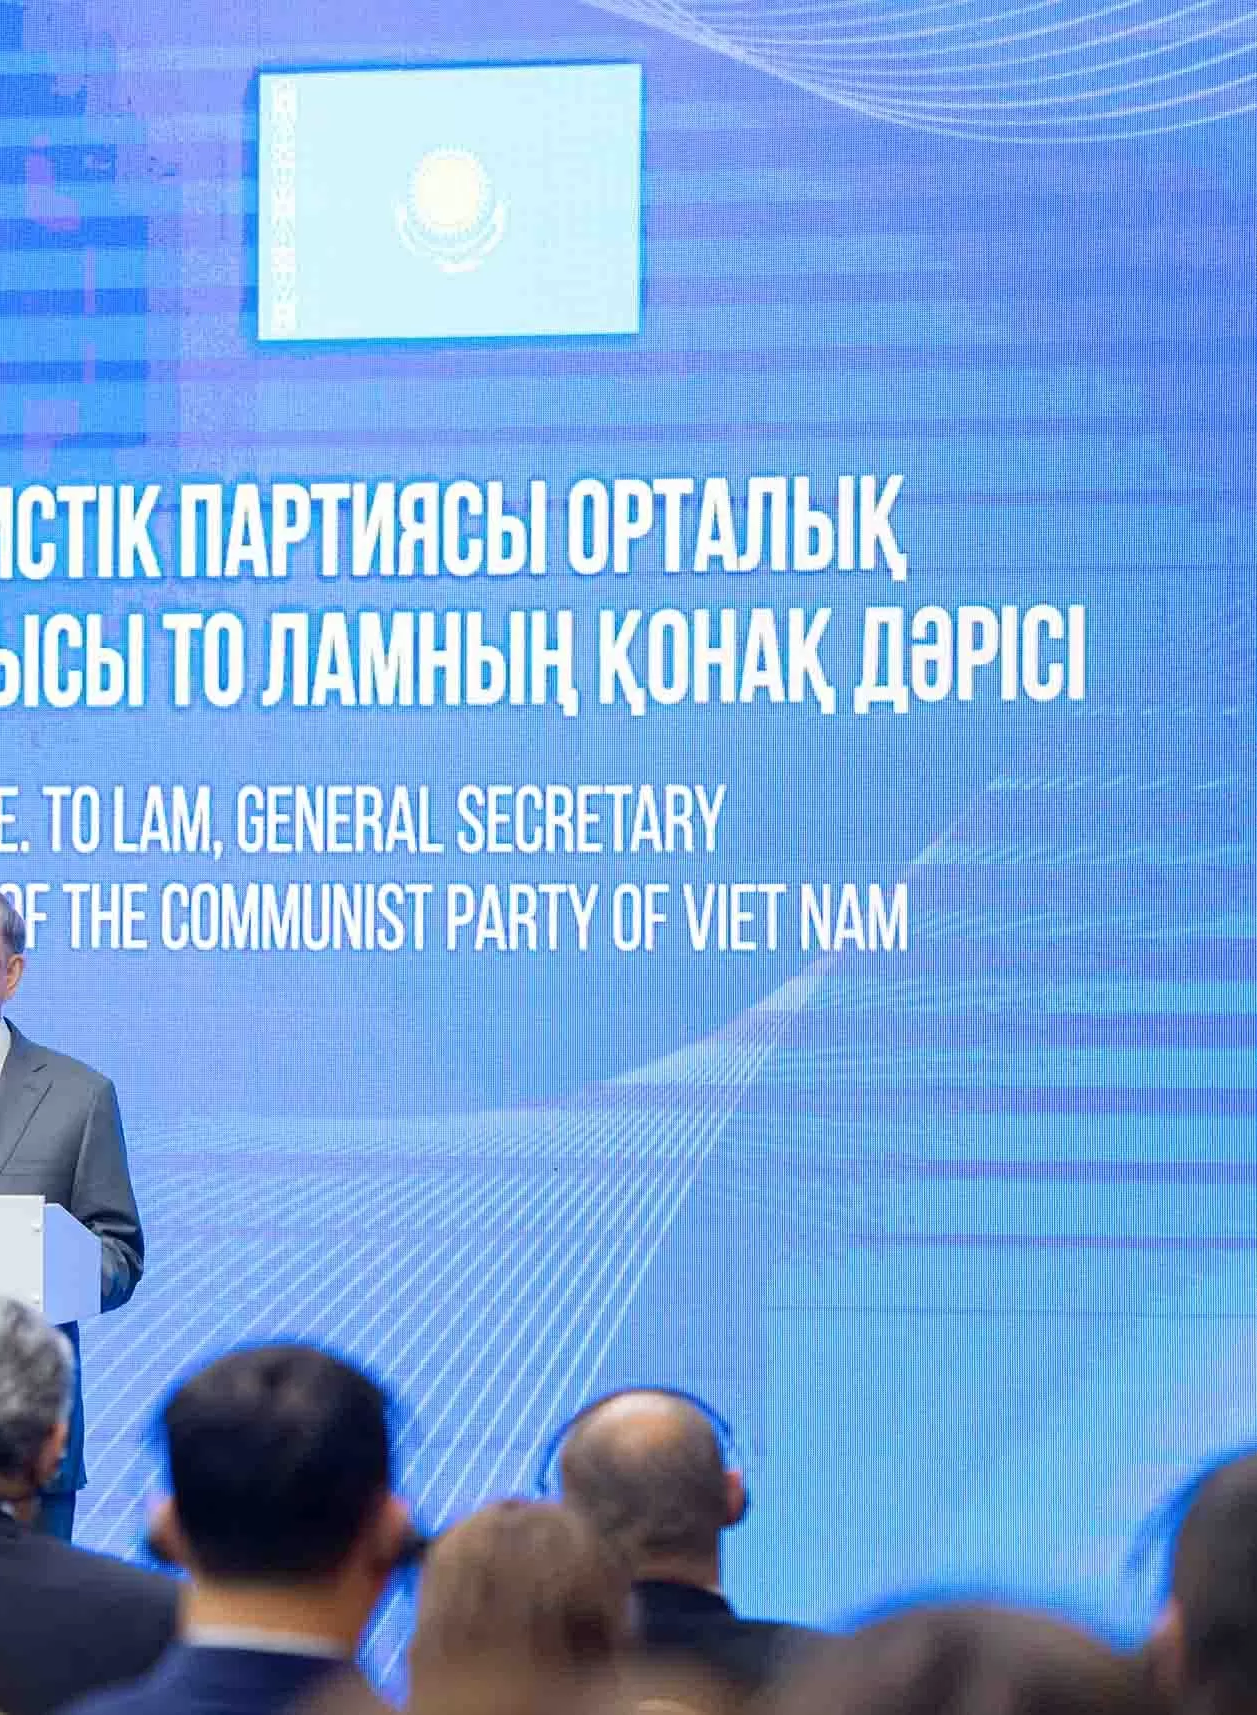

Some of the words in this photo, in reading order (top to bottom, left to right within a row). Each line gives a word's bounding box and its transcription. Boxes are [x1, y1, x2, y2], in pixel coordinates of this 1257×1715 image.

[181, 480, 546, 577] ПАРТИЯСЫ
[569, 475, 907, 581] ОРТАЛЫҚ
[163, 613, 243, 706] ТО
[262, 611, 577, 717] ЛАМНЫҢ
[600, 607, 835, 716] ҚОНАҚ
[854, 605, 1084, 713] ДӘРІСІ
[43, 786, 100, 853] TO
[114, 786, 224, 861] LAM,
[237, 786, 441, 853] GENERAL
[458, 784, 725, 853] SECRETARY
[62, 883, 148, 949] THE
[162, 883, 433, 950] COMMUNIST
[447, 884, 598, 950] PARTY
[613, 883, 669, 951] OF
[683, 883, 785, 950] VIET
[801, 883, 908, 950] NAM
